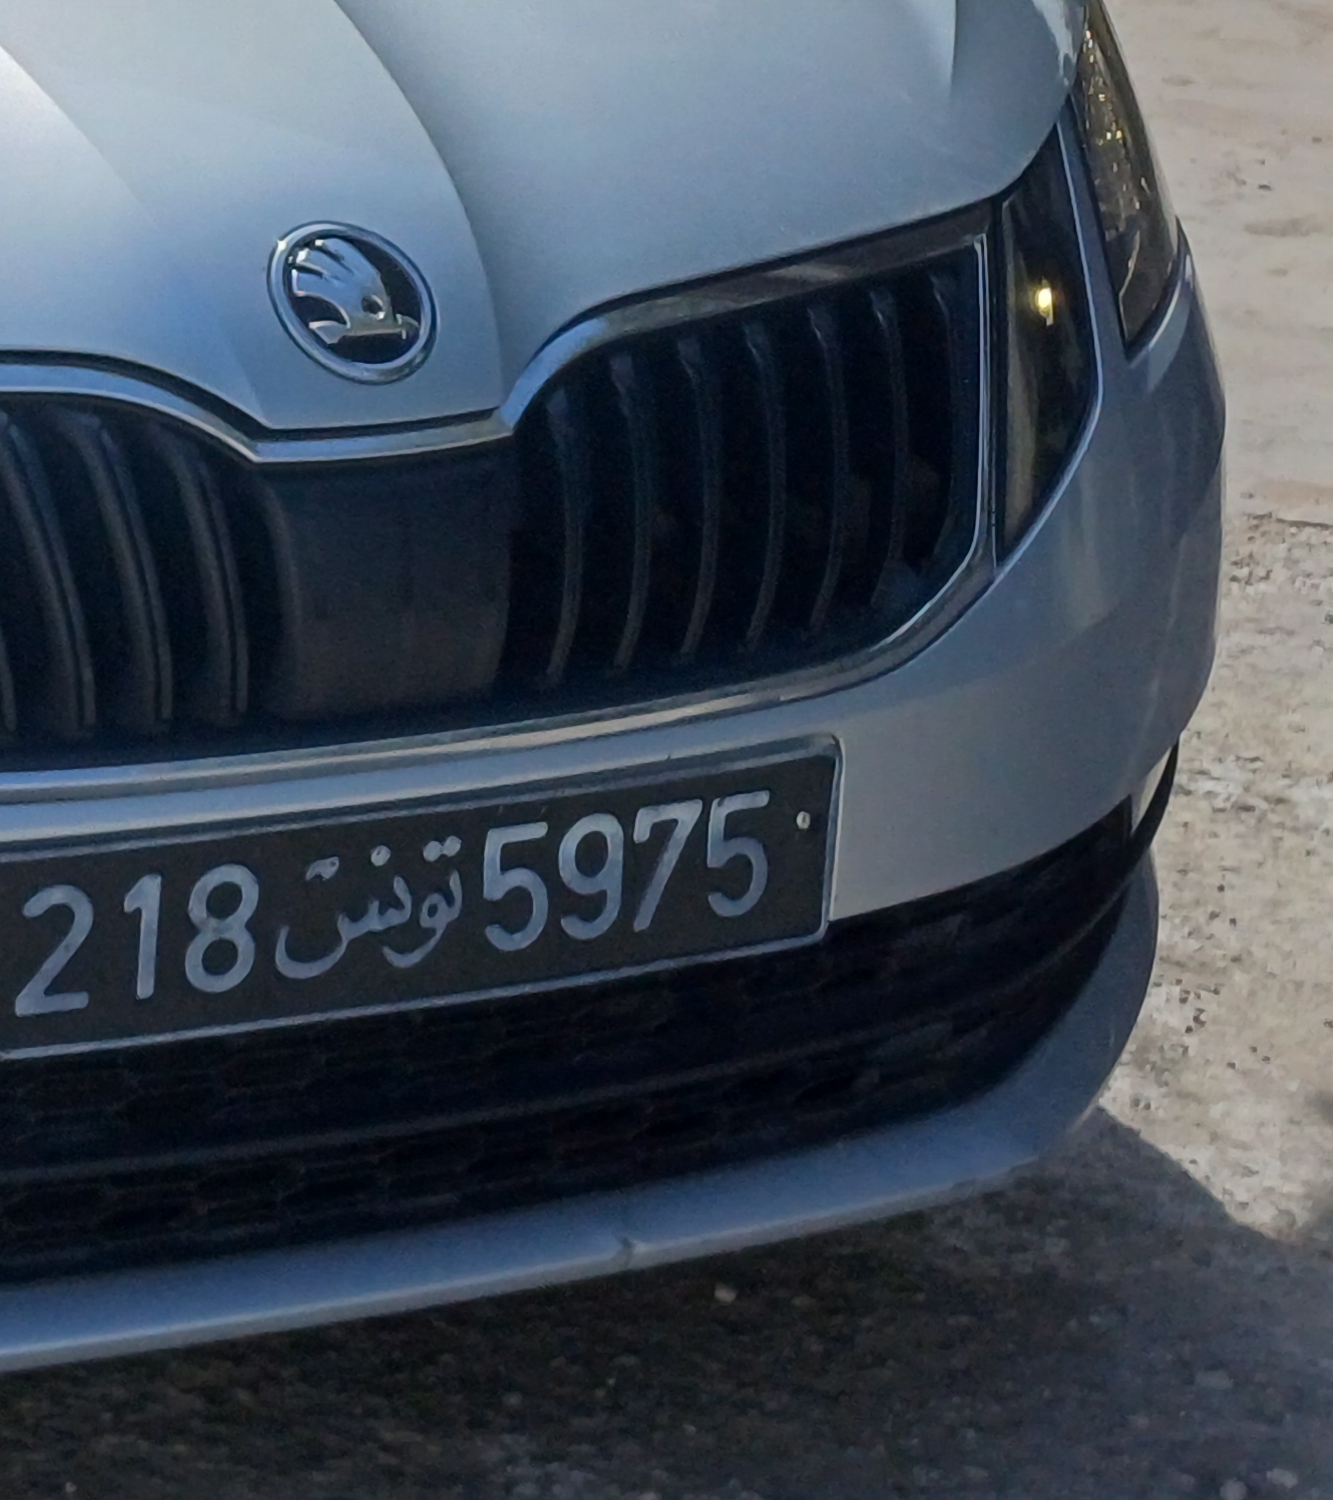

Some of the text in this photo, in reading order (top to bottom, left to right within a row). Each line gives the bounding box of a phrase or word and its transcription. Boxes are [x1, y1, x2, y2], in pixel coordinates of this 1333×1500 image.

[15, 790, 770, 1018] 218 تونس 5975
